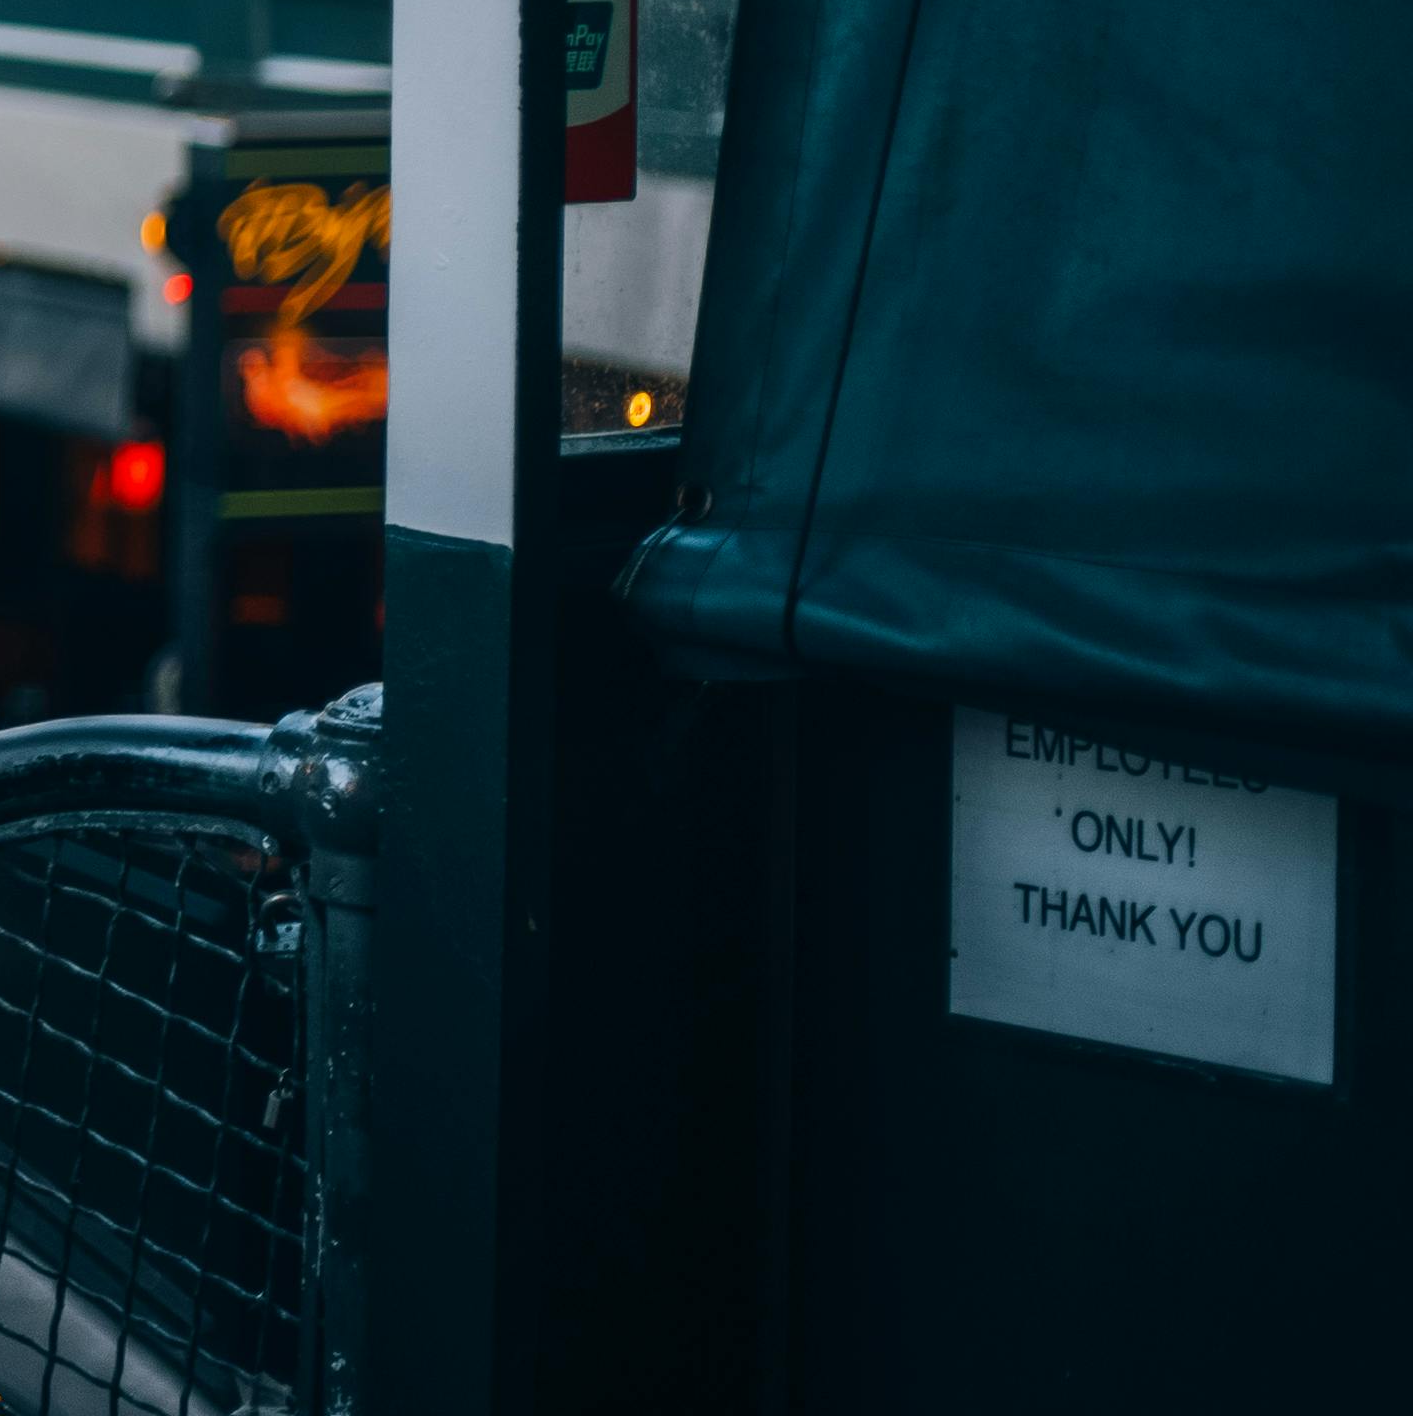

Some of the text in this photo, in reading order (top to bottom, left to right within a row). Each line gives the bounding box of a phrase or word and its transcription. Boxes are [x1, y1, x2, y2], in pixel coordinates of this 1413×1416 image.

[1071, 810, 1196, 867] ONLY!
[1013, 882, 1263, 962] THANK YOU
